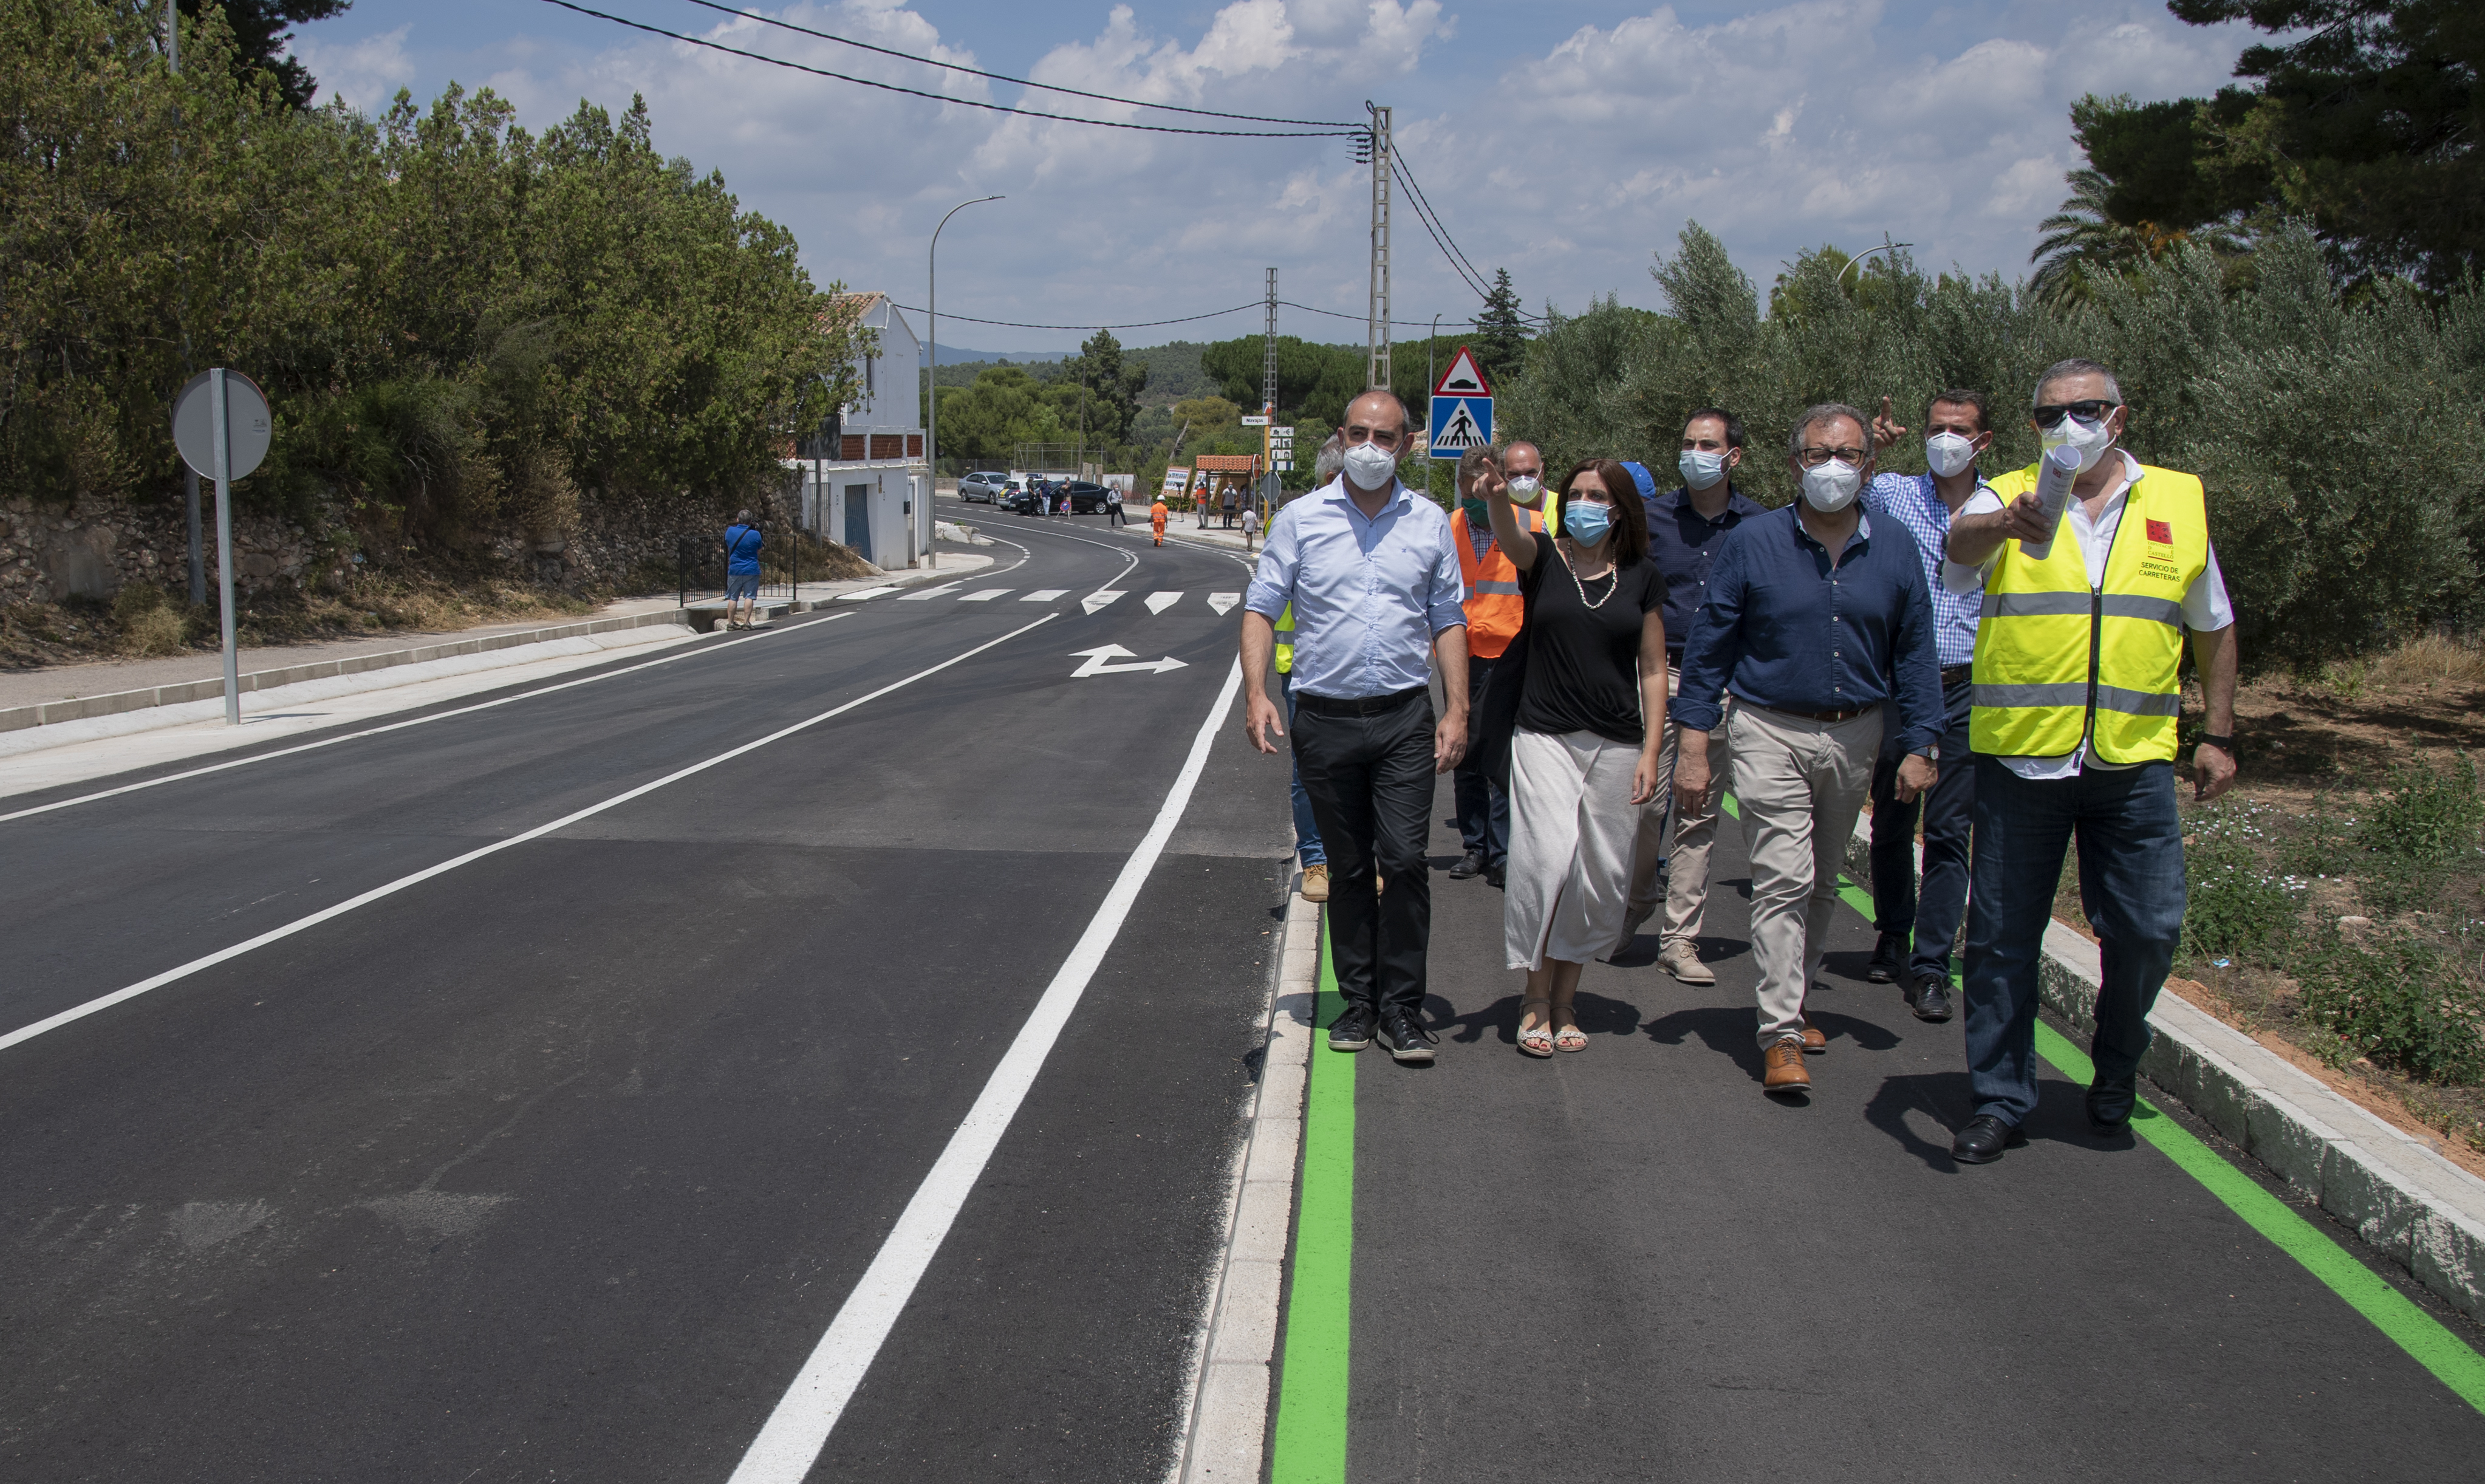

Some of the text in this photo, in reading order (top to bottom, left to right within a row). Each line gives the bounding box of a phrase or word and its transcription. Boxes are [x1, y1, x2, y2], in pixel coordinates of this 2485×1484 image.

[2147, 550, 2174, 559] CASTELLÓ
[2141, 562, 2169, 572] SERVICIO
[2138, 570, 2181, 582] CARRETERAS
